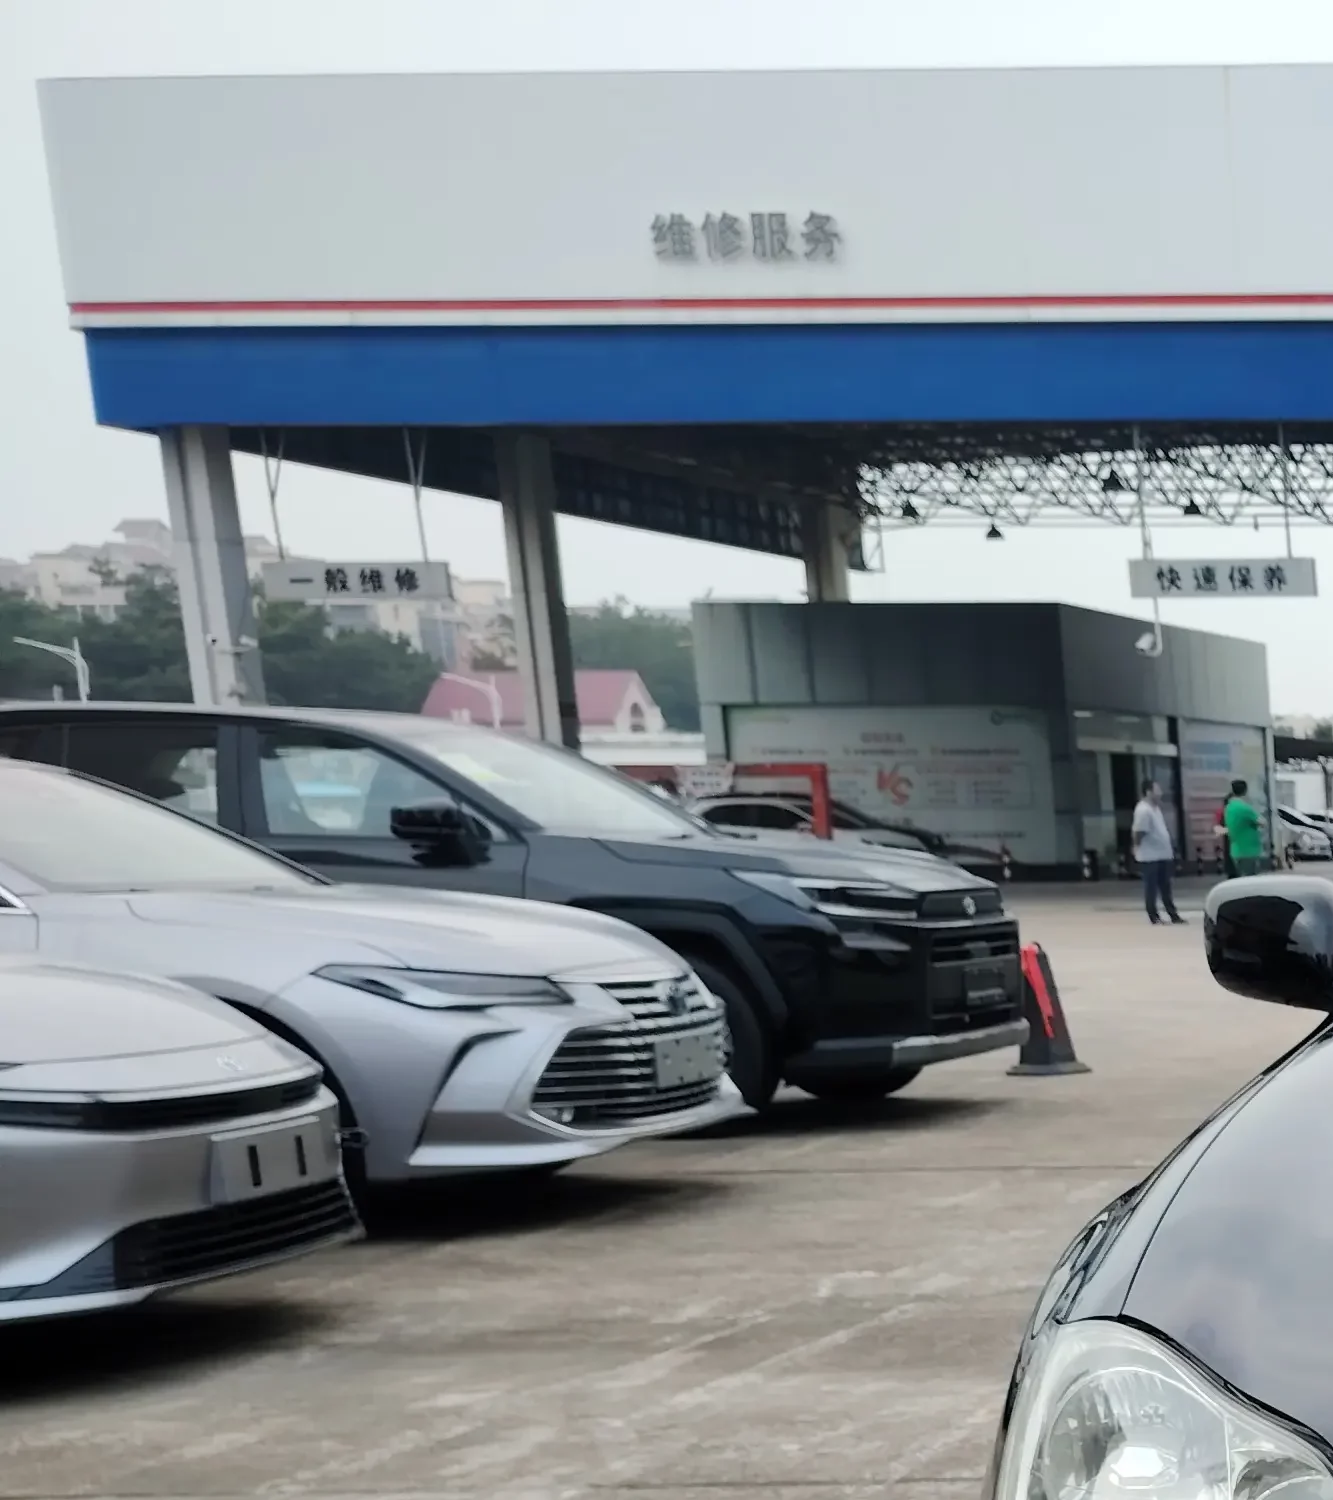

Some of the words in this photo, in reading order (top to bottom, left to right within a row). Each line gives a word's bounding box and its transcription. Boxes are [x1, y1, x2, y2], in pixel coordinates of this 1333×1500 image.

[650, 210, 843, 260] 维修服务
[289, 567, 420, 593] 一般维修
[1156, 564, 1287, 592] 快速保养
